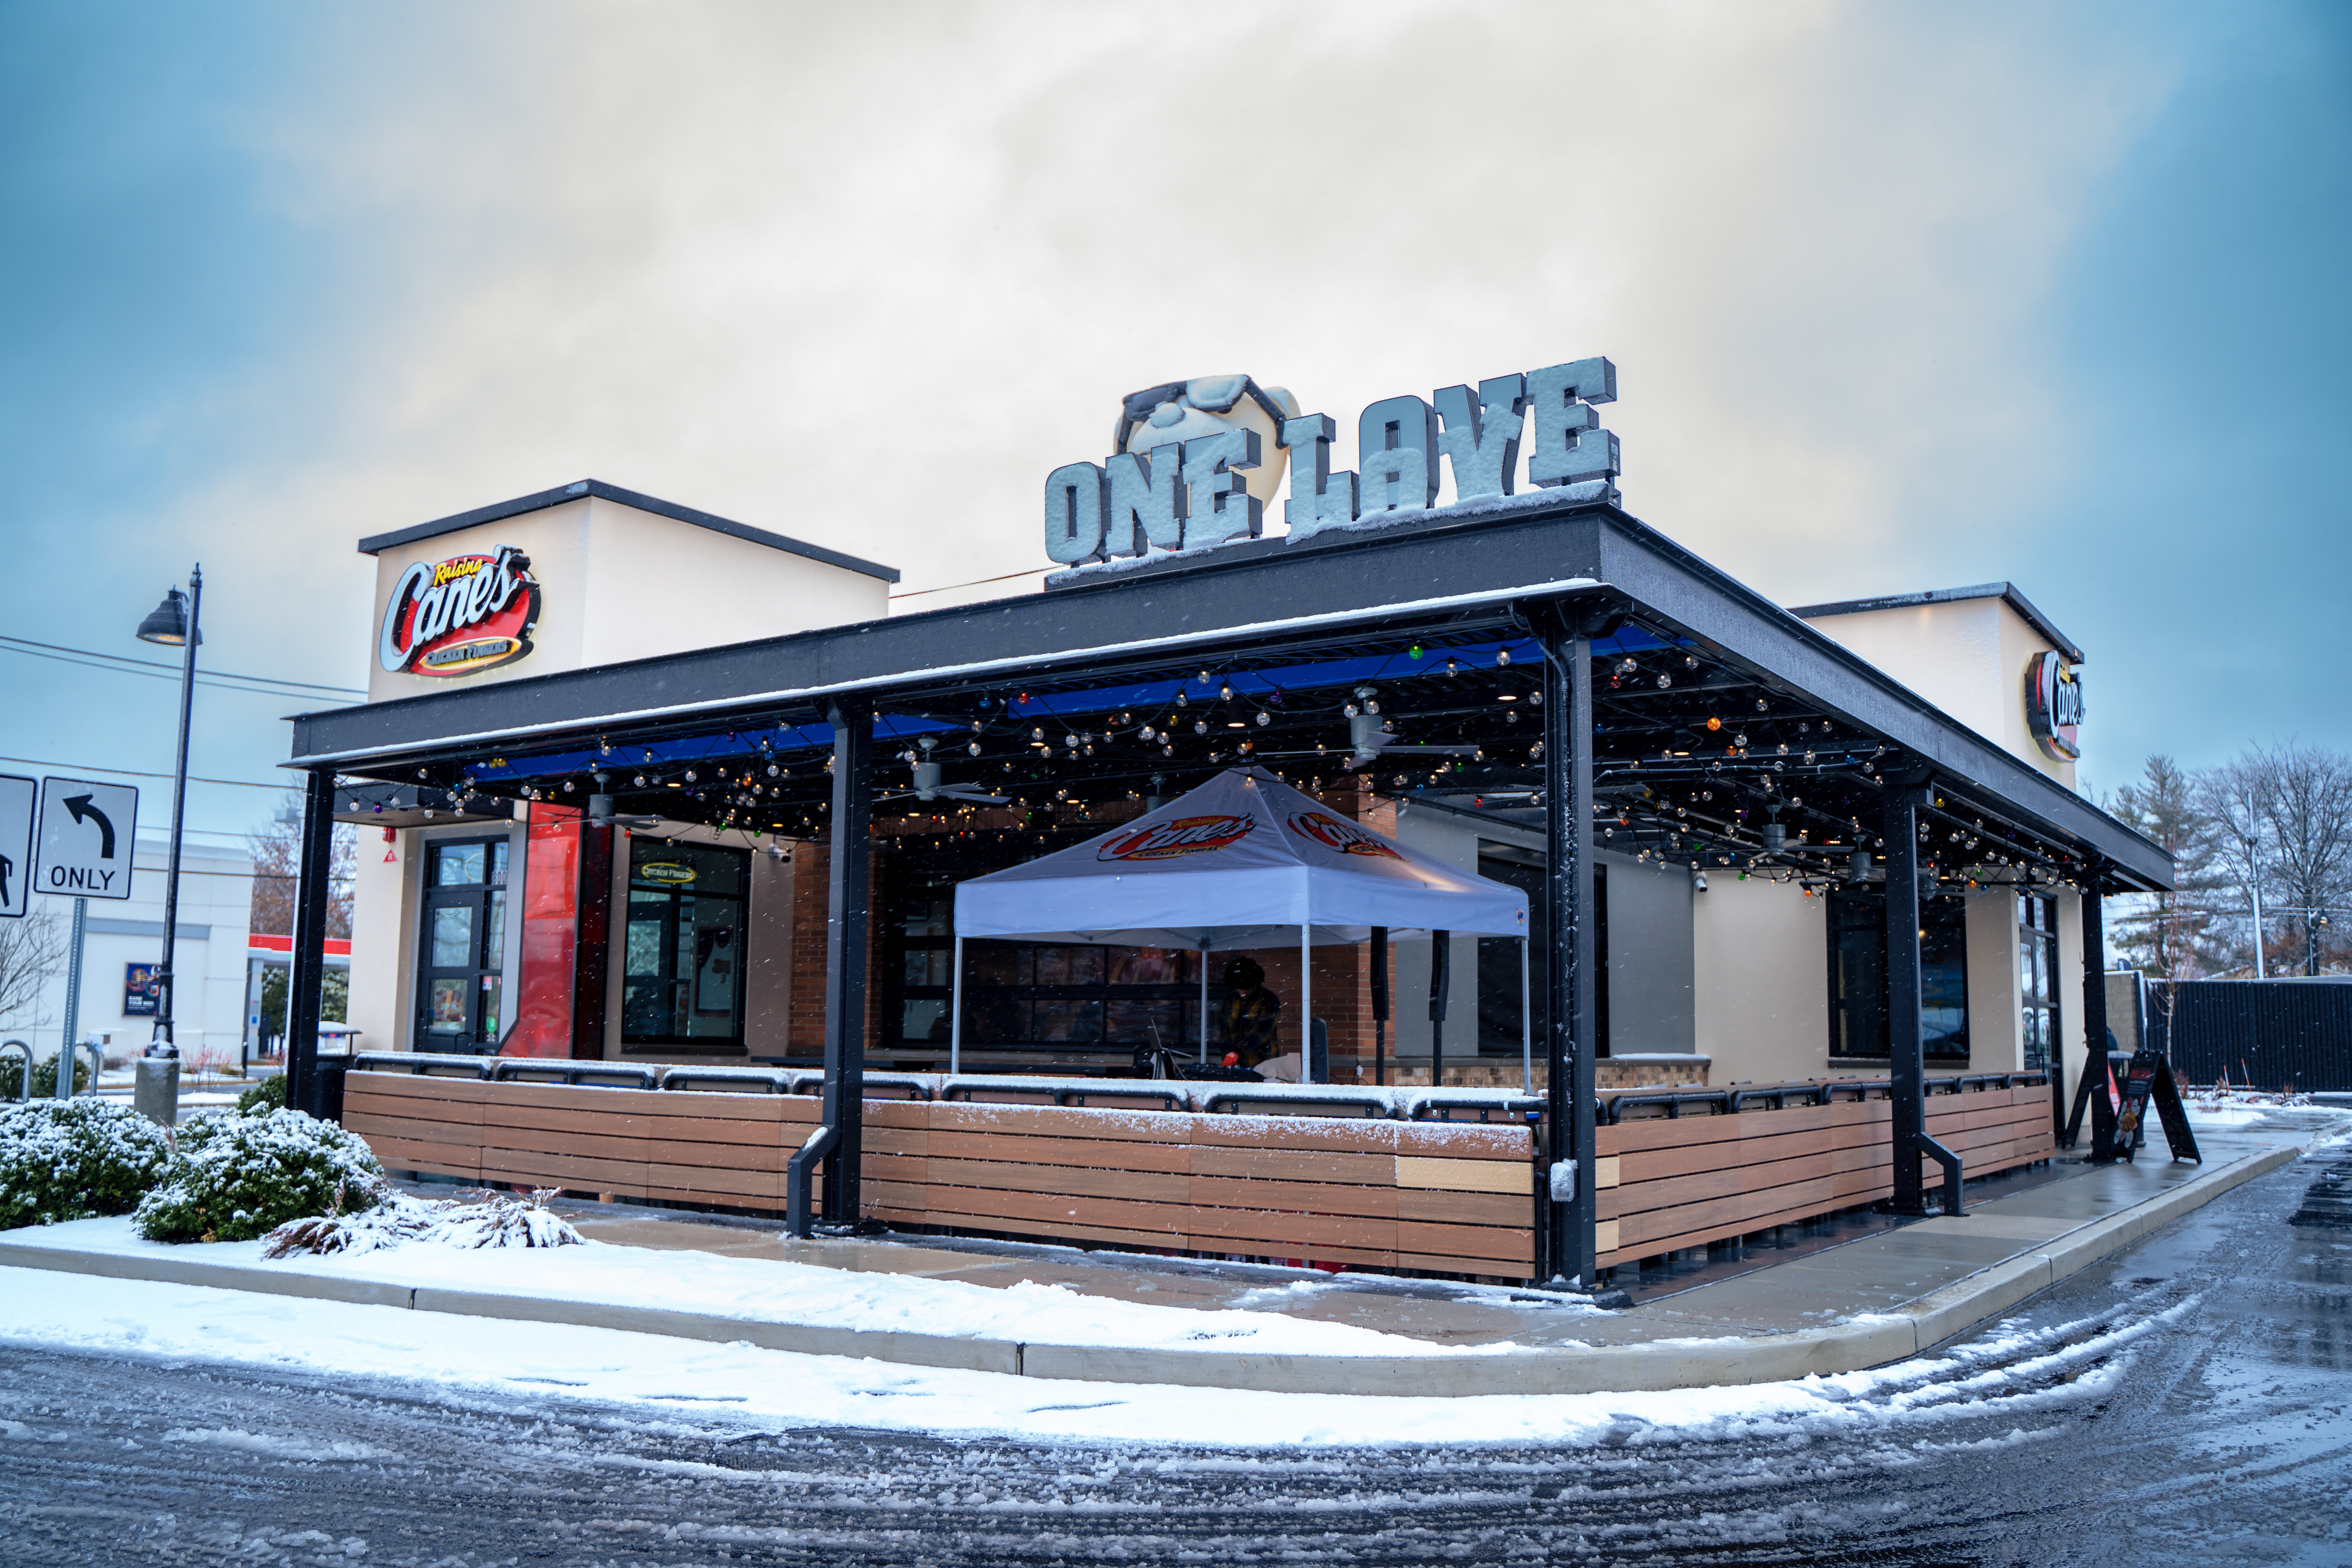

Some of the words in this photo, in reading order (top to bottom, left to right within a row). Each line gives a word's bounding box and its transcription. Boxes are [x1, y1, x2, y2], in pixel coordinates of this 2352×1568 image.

[1045, 428, 1261, 565] ONE
[1283, 356, 1618, 544] LOVE
[433, 557, 483, 586] Raising
[380, 544, 520, 672] Cane's
[426, 649, 464, 665] CHICKEN
[466, 639, 507, 659] FINGERS
[1171, 817, 1223, 829] Raising
[1097, 812, 1257, 862] Cane's
[1178, 846, 1218, 854] FINGERS
[51, 865, 116, 891] ONLY
[492, 871, 506, 884] 800
[643, 867, 669, 877] CHICKEN
[669, 869, 693, 879] FINGERS
